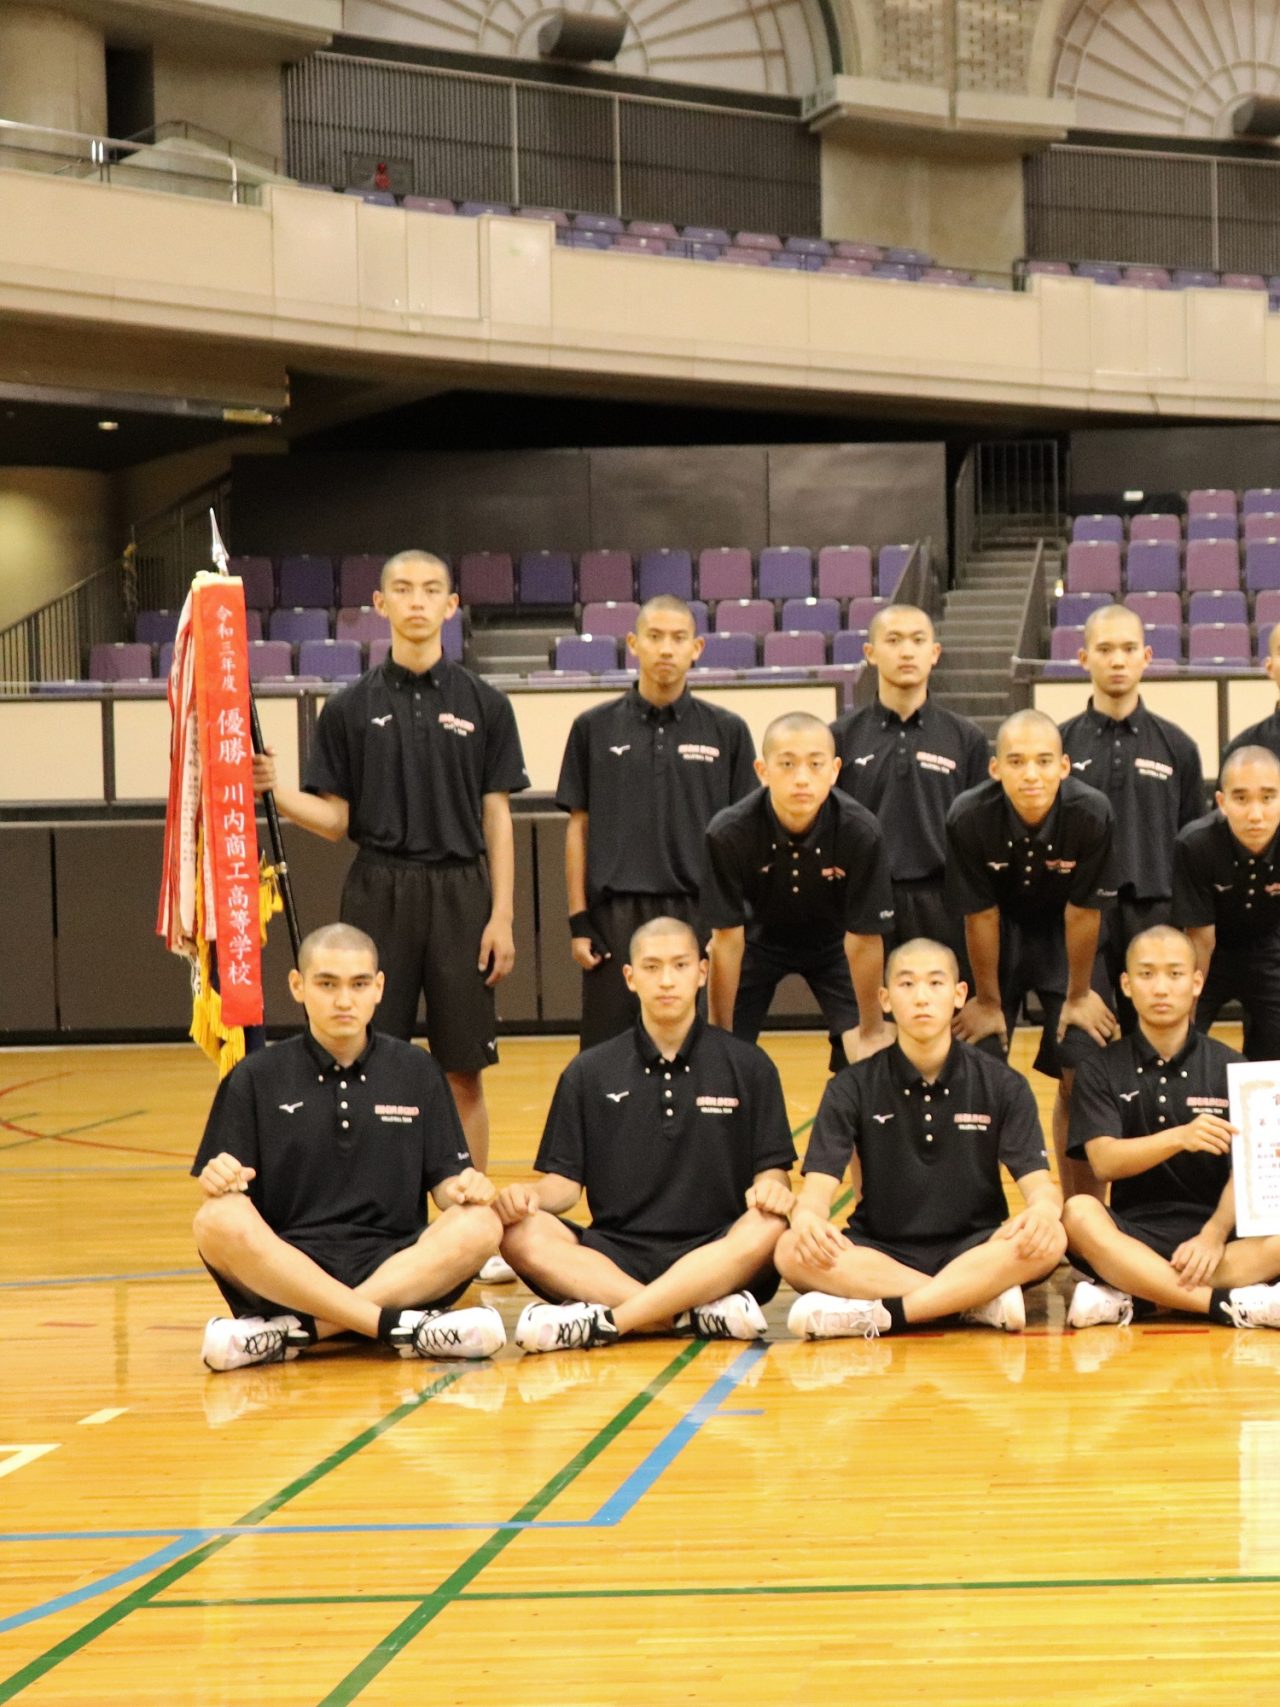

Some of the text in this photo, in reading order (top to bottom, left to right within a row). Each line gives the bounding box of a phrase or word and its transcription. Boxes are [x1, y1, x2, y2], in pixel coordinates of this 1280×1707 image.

[216, 605, 253, 986] 令和三年度 優勝 川内商工高等学校
